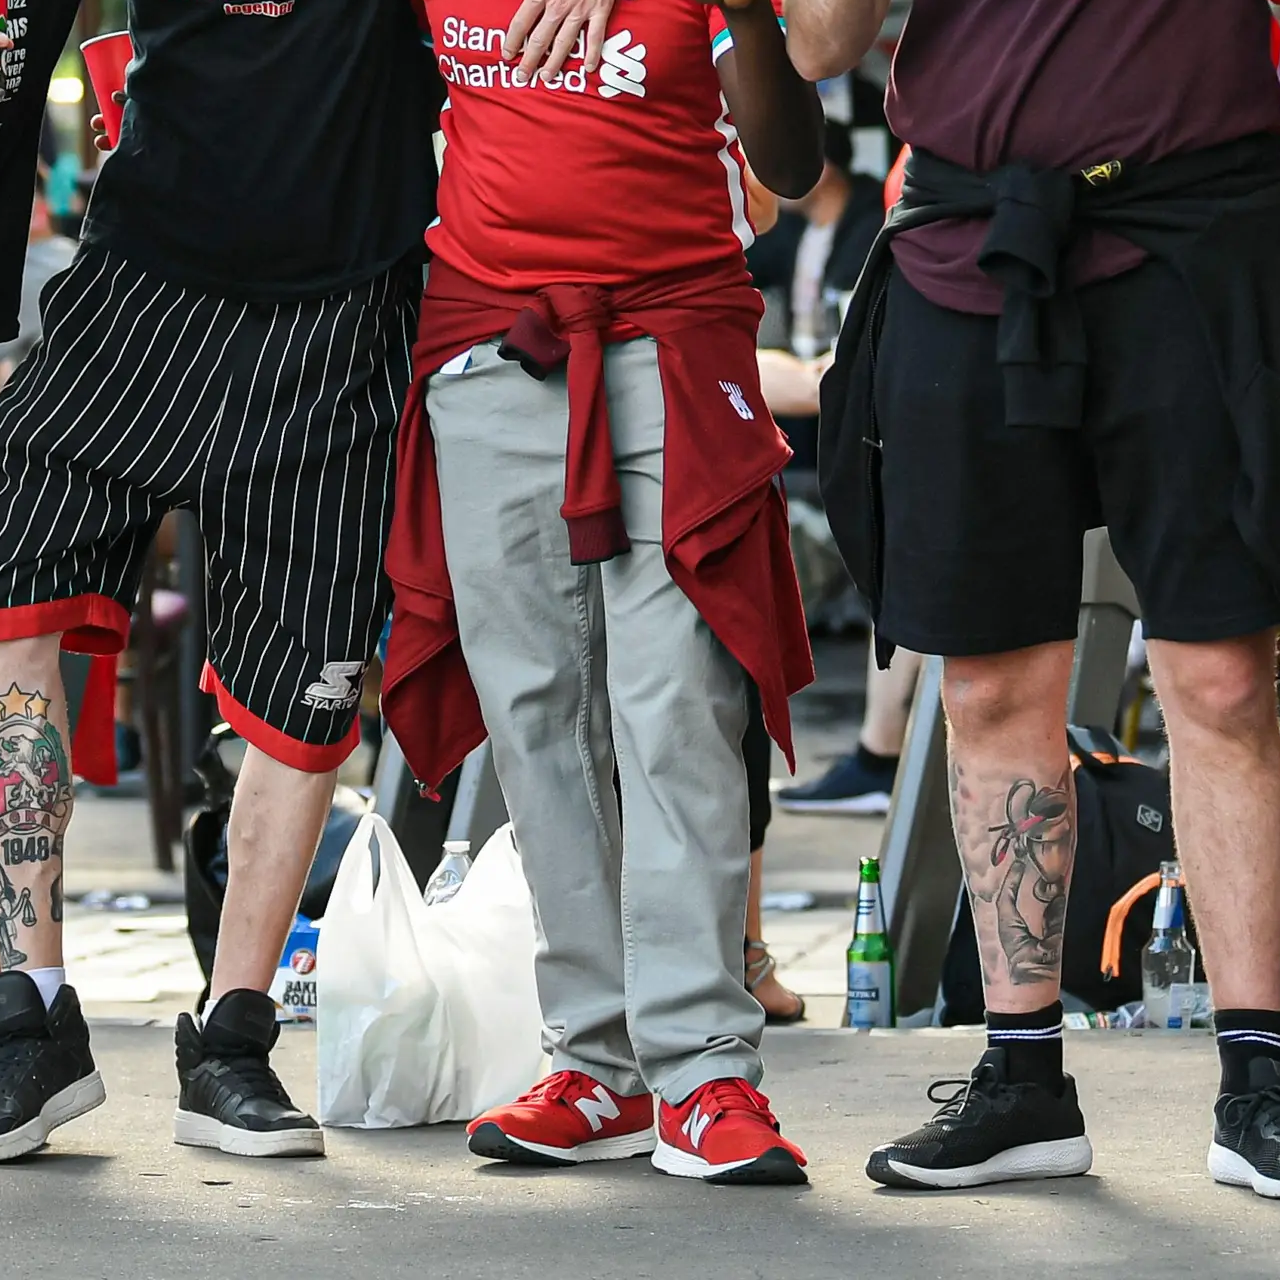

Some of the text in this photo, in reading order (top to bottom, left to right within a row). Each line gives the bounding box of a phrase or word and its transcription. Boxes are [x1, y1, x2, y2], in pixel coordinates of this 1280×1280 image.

[223, 0, 295, 18] together
[442, 15, 585, 59] Stand
[0, 835, 50, 866] 1948
